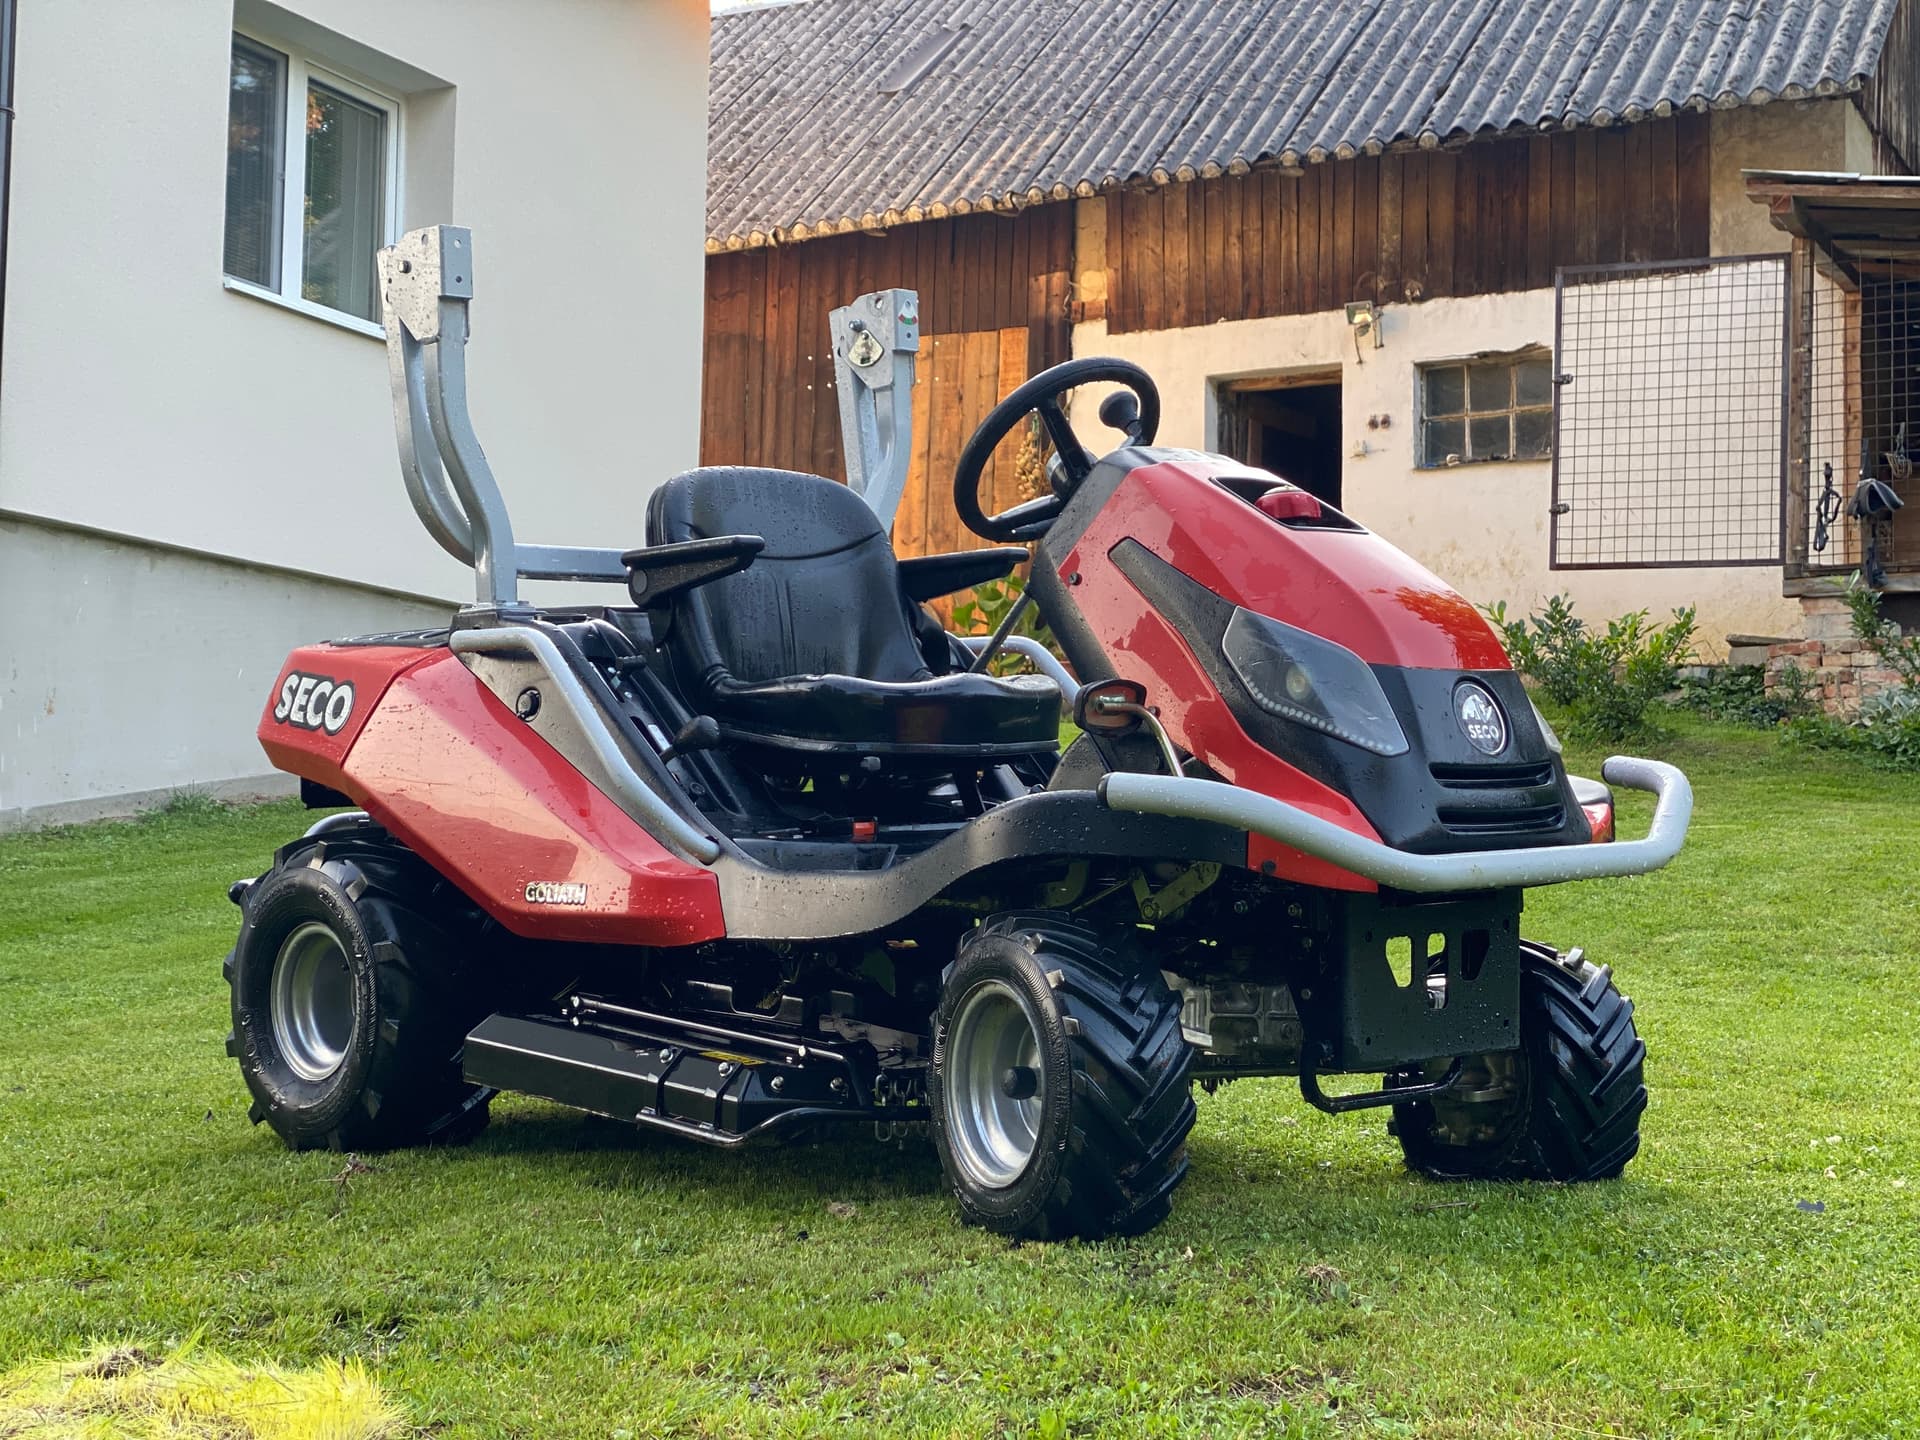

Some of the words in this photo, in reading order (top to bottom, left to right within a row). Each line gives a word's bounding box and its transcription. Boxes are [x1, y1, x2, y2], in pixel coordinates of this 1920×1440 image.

[275, 674, 353, 731] SECO
[1468, 724, 1499, 741] SECO
[525, 883, 587, 904] GOLIATH
